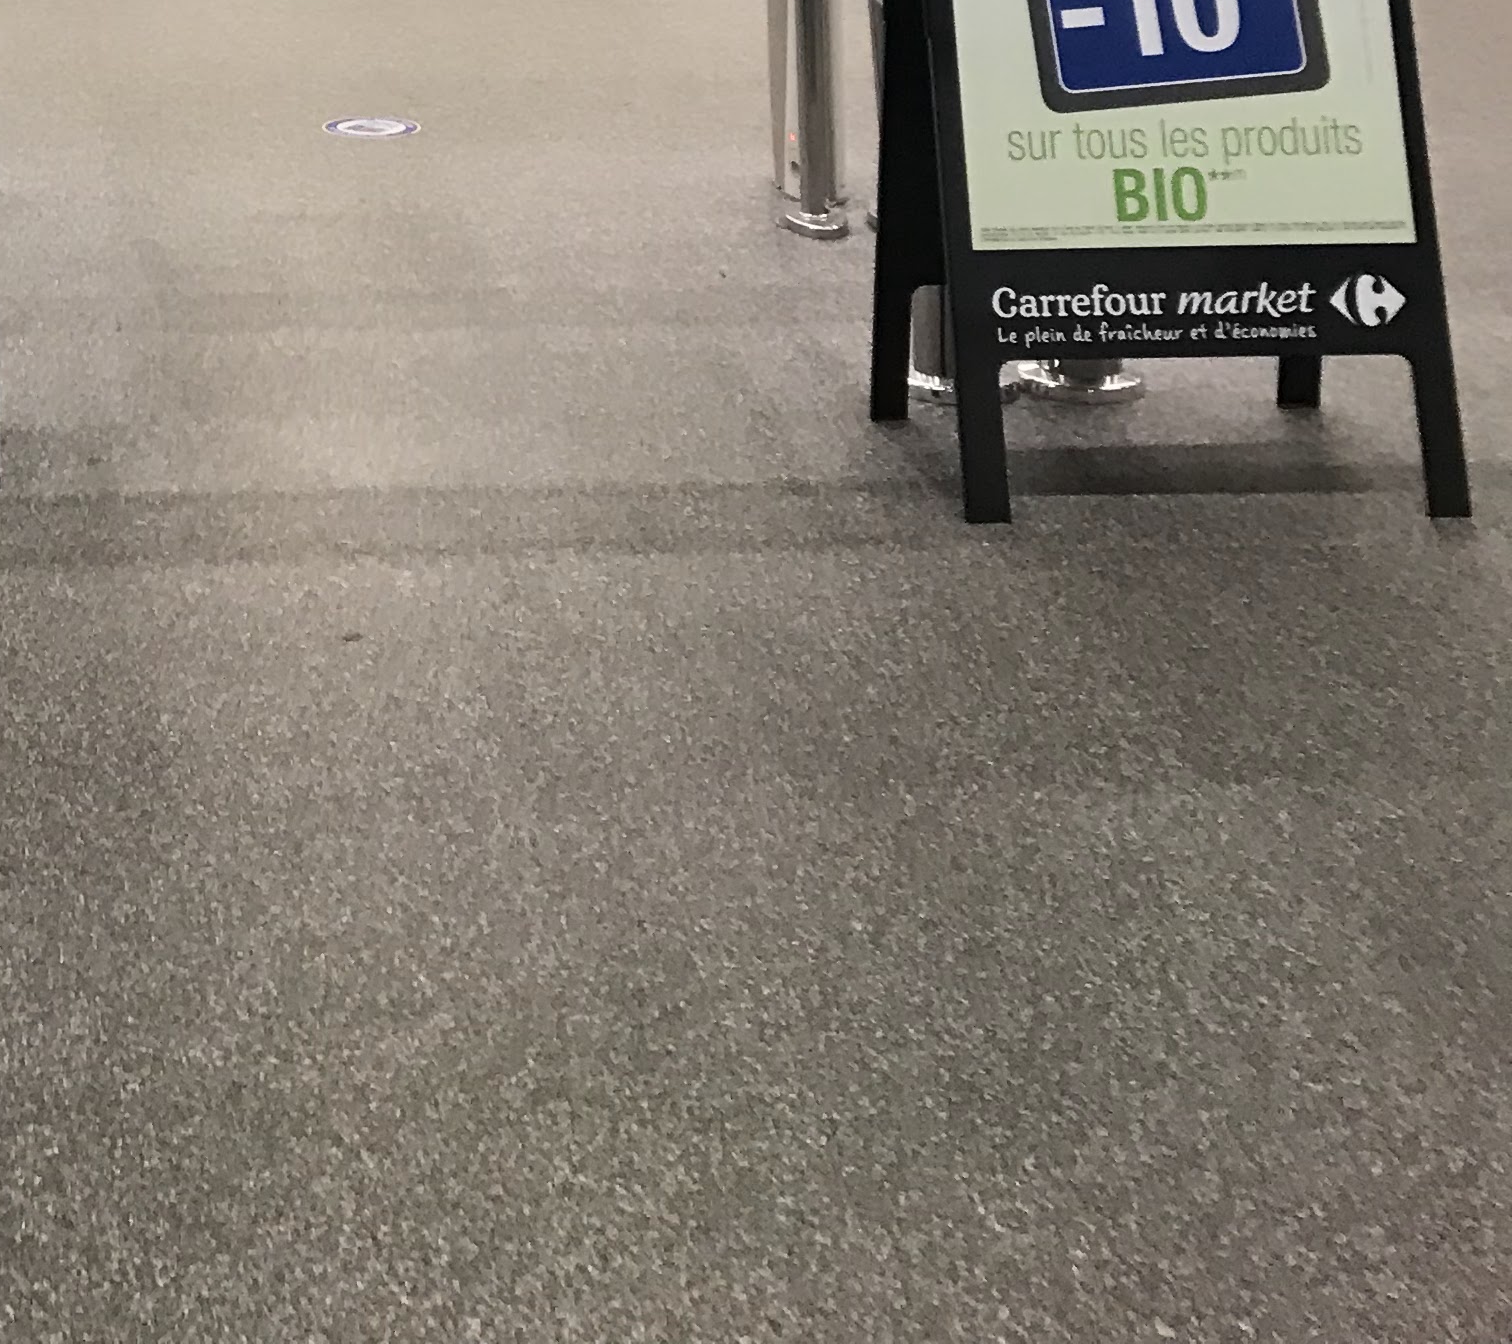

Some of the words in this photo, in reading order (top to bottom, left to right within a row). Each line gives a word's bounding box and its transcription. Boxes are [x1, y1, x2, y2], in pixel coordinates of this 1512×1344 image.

[1007, 128, 1063, 161] sur
[1073, 122, 1149, 160] tous
[1160, 119, 1209, 159] les
[1221, 115, 1364, 166] produits
[991, 283, 1167, 320] Carrefour
[1176, 281, 1318, 319] market
[997, 325, 1018, 344] Le
[1024, 325, 1067, 349] plein
[1072, 324, 1093, 344] de
[1098, 321, 1184, 344] fraîcheur
[1189, 321, 1209, 341] et
[1213, 320, 1318, 341] d'économies
